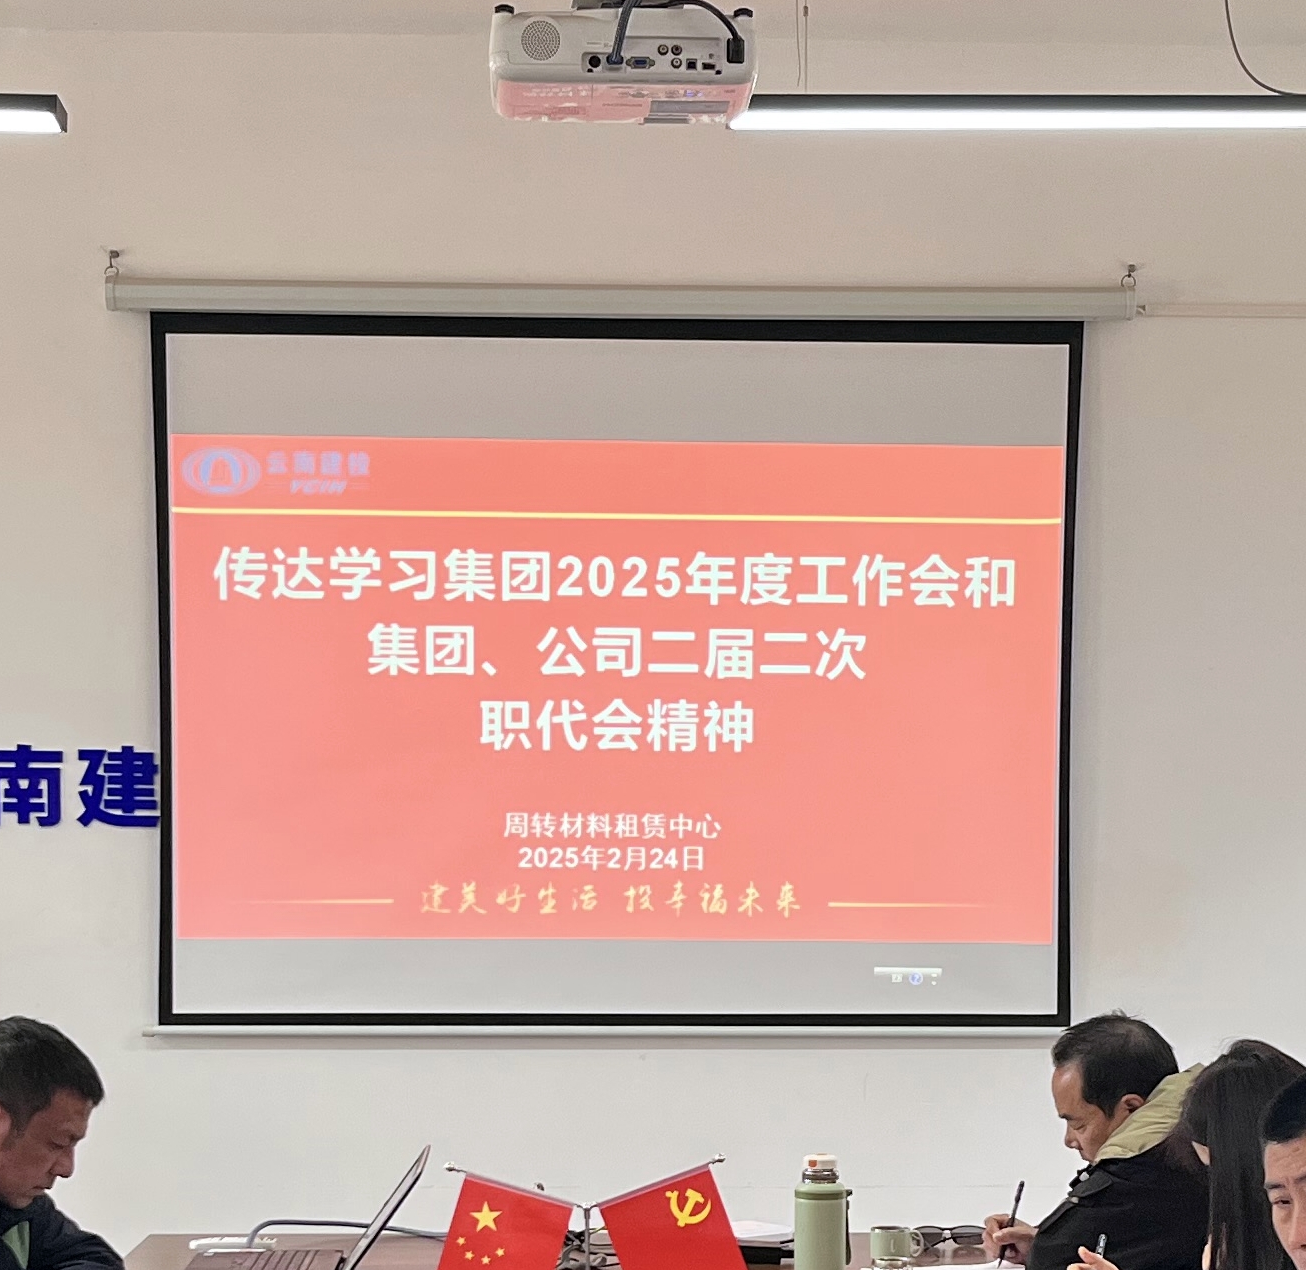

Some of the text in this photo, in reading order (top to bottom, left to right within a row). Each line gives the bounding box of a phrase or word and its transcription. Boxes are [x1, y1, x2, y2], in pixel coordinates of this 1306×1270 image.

[213, 546, 1017, 609] 传达学习集团2025年度工作会和
[366, 622, 868, 682] 集团、公司二届二次
[479, 698, 755, 755] 职代会精神
[503, 811, 722, 840] 周转材料租赁中心
[517, 845, 705, 873] 2025年2月24日
